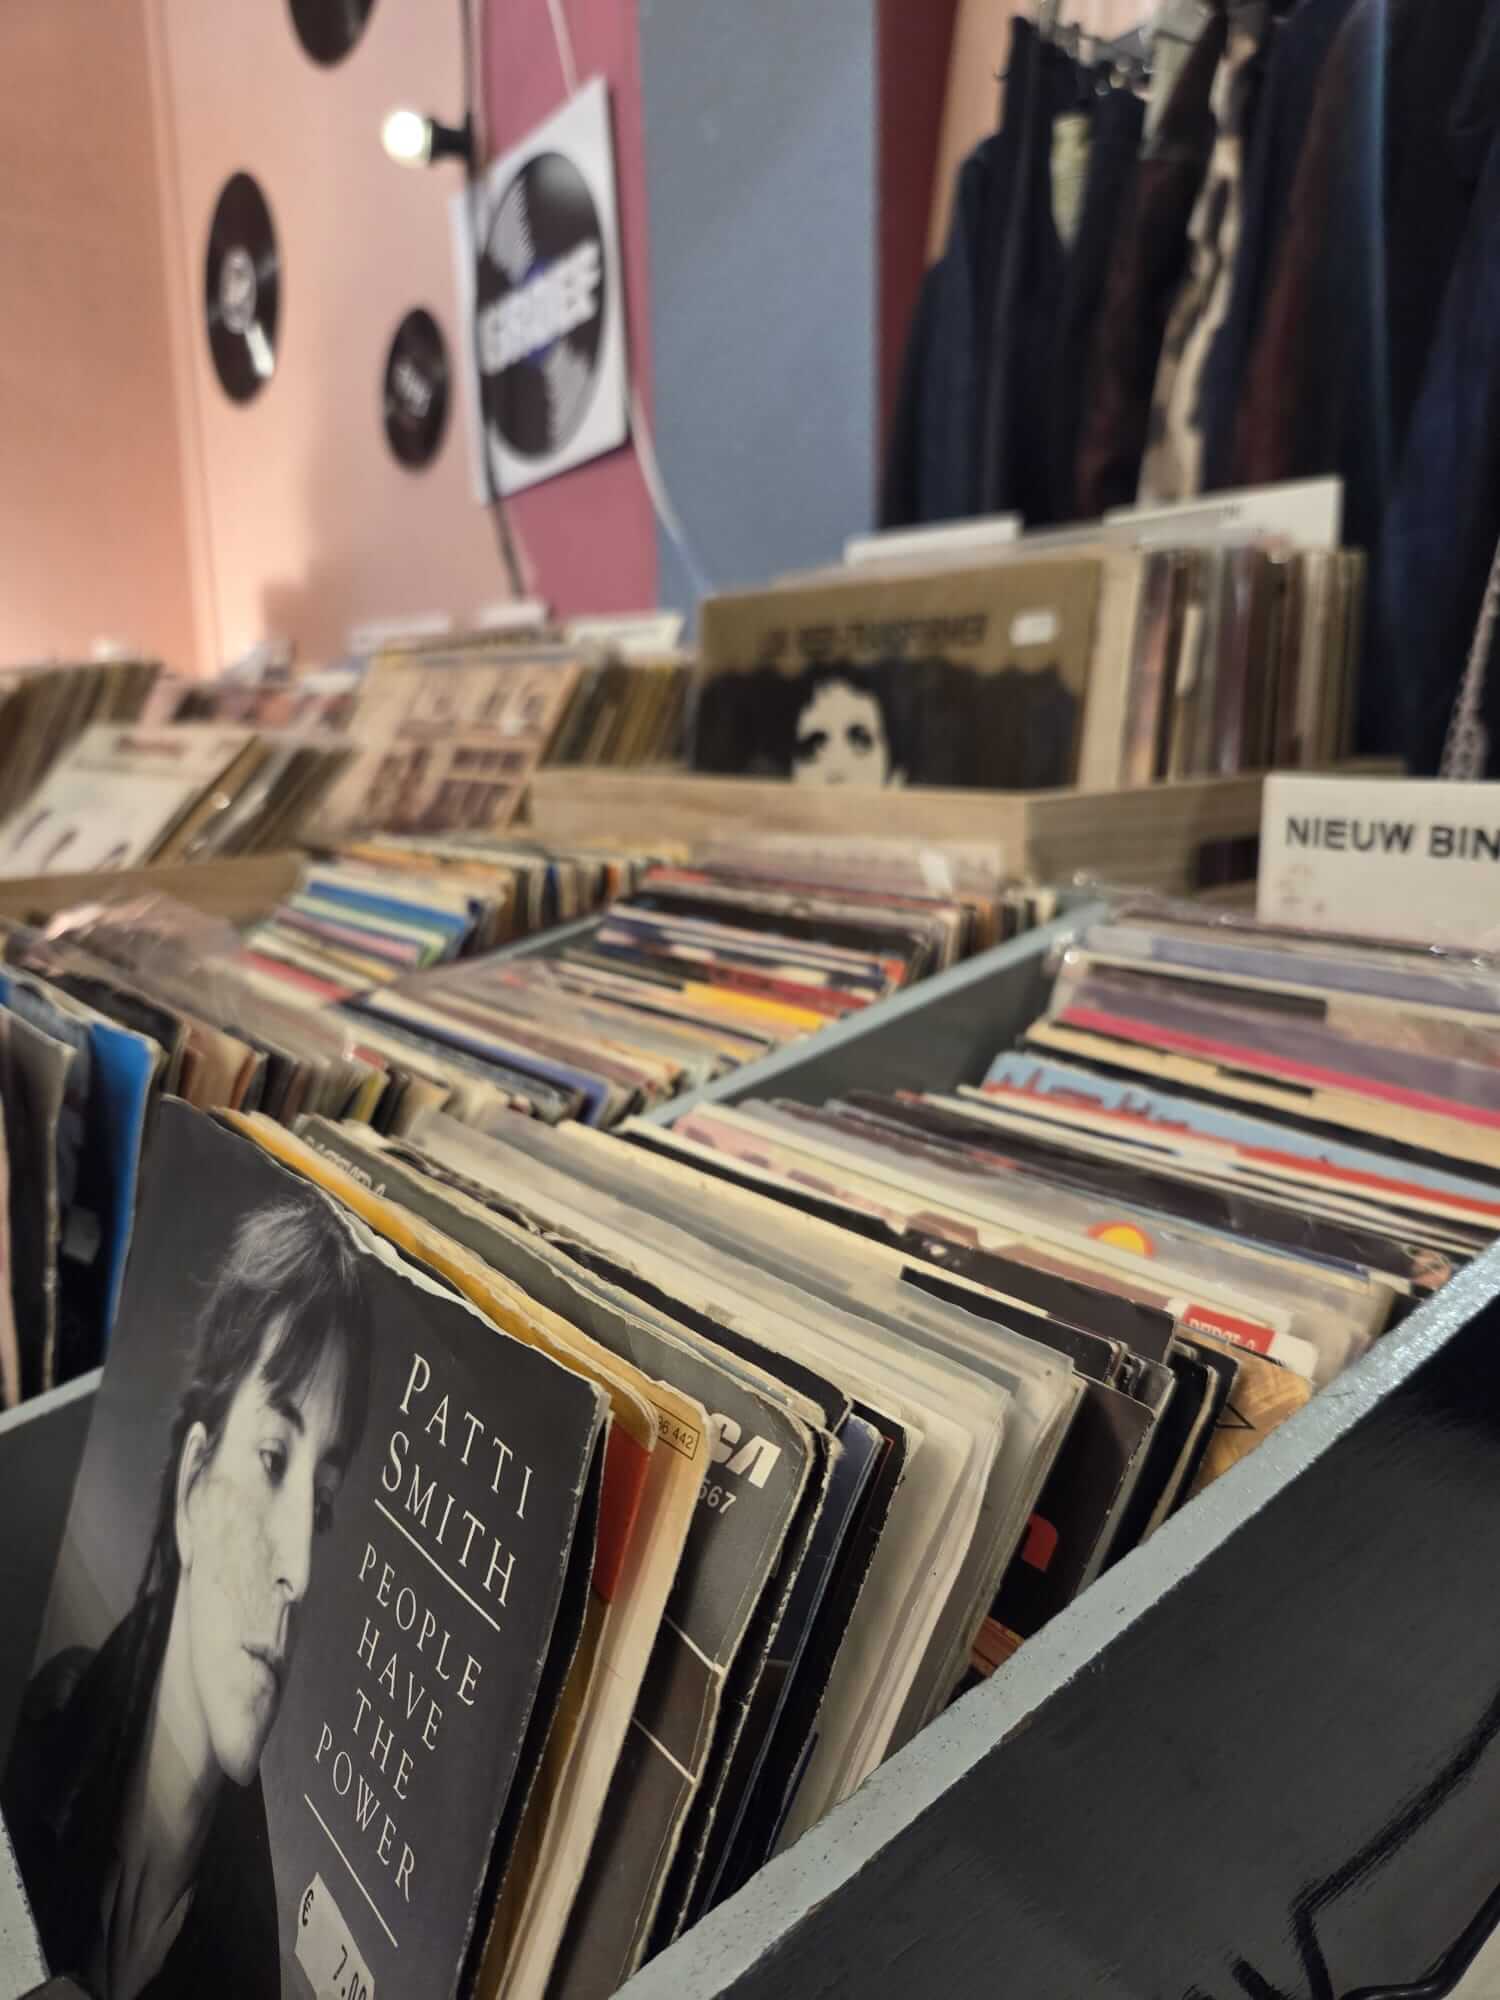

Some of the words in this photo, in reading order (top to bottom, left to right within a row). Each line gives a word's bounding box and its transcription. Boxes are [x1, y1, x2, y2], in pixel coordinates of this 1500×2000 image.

[1285, 816, 1416, 854] NIEUW
[400, 1352, 533, 1519] PATTI
[672, 1426, 694, 1451] 442
[381, 1430, 516, 1608] SMITH
[356, 1617, 443, 1751] HAVE
[358, 1542, 482, 1706] PEOPLE
[314, 1721, 415, 1903] POWER
[352, 1687, 414, 1800] THE
